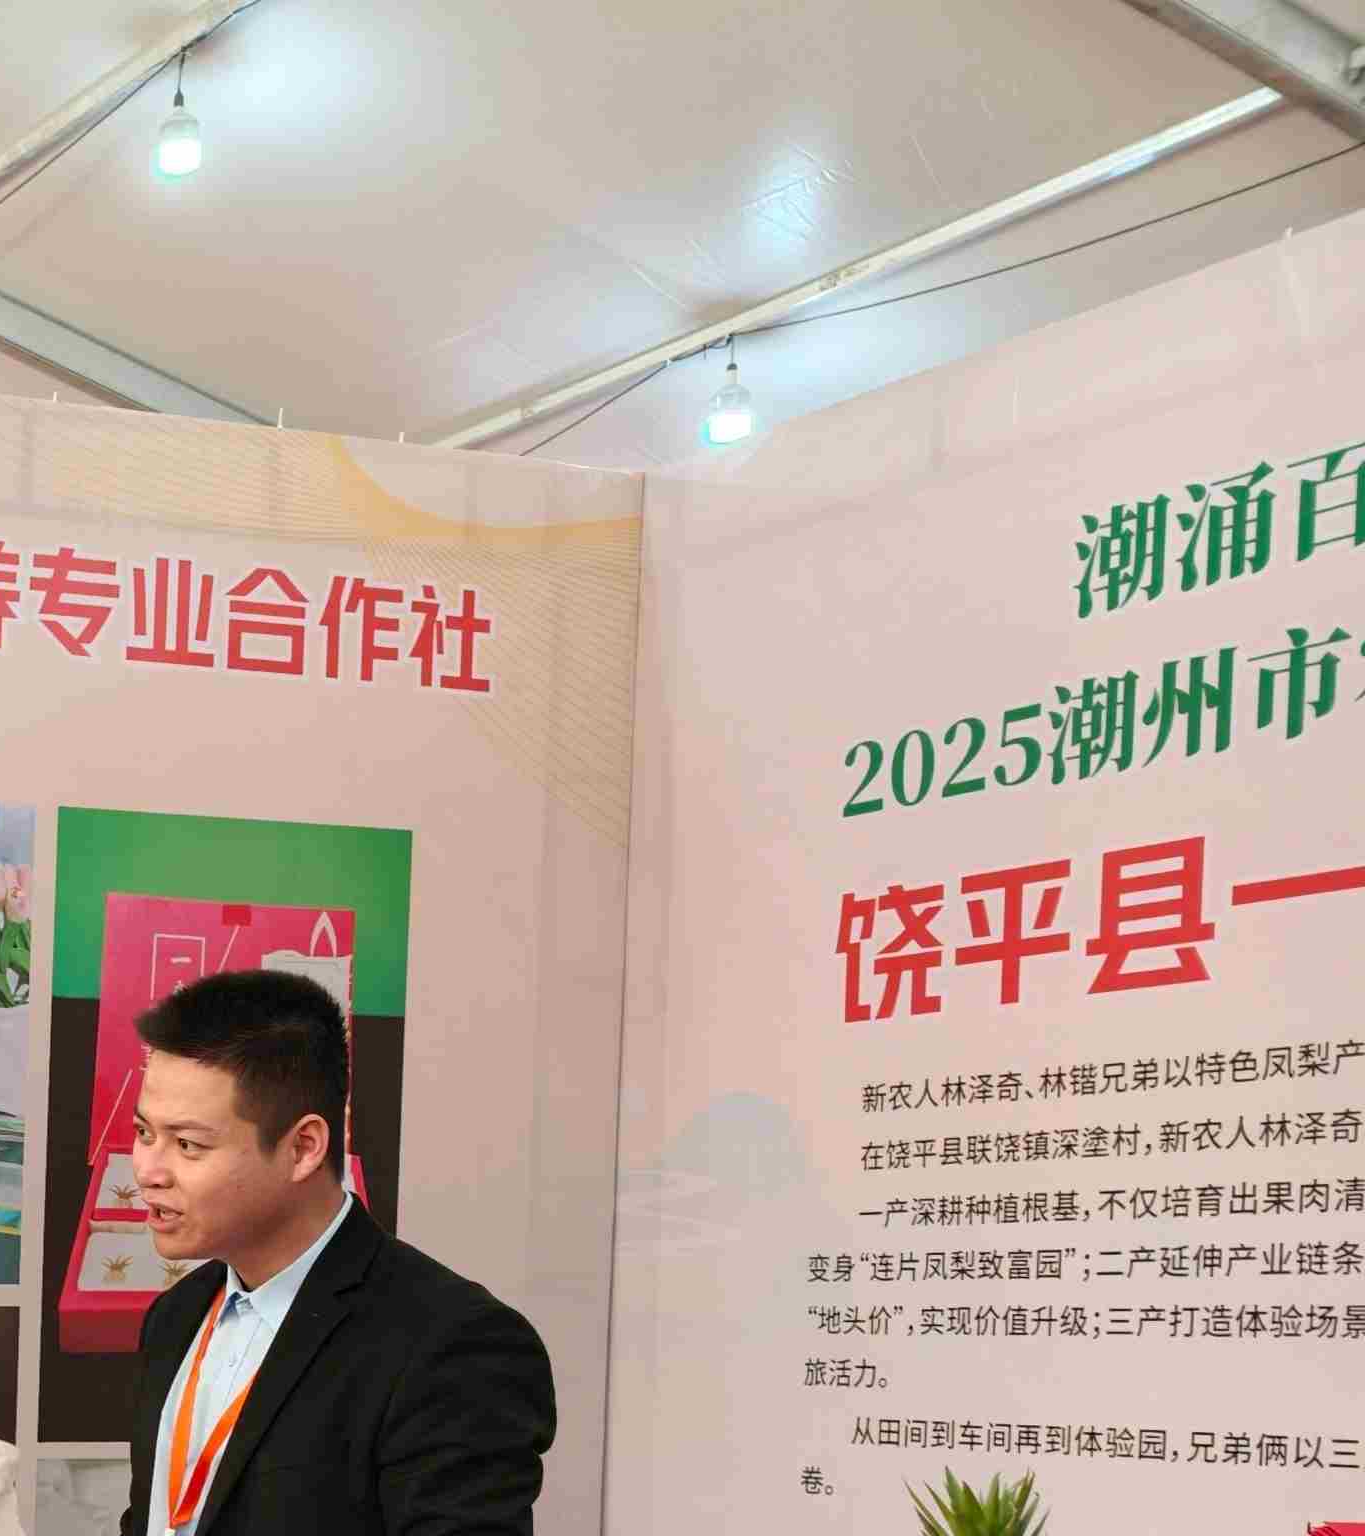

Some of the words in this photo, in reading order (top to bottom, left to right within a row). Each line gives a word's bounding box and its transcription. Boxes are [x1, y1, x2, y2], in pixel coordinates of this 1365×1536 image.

[1073, 443, 1365, 618] 潮涌百
[842, 627, 1365, 818] 2025潮州市
[835, 836, 1365, 1022] 饶平县一
[804, 1358, 888, 1389] 旅活力。
[800, 1466, 835, 1496] 卷。
